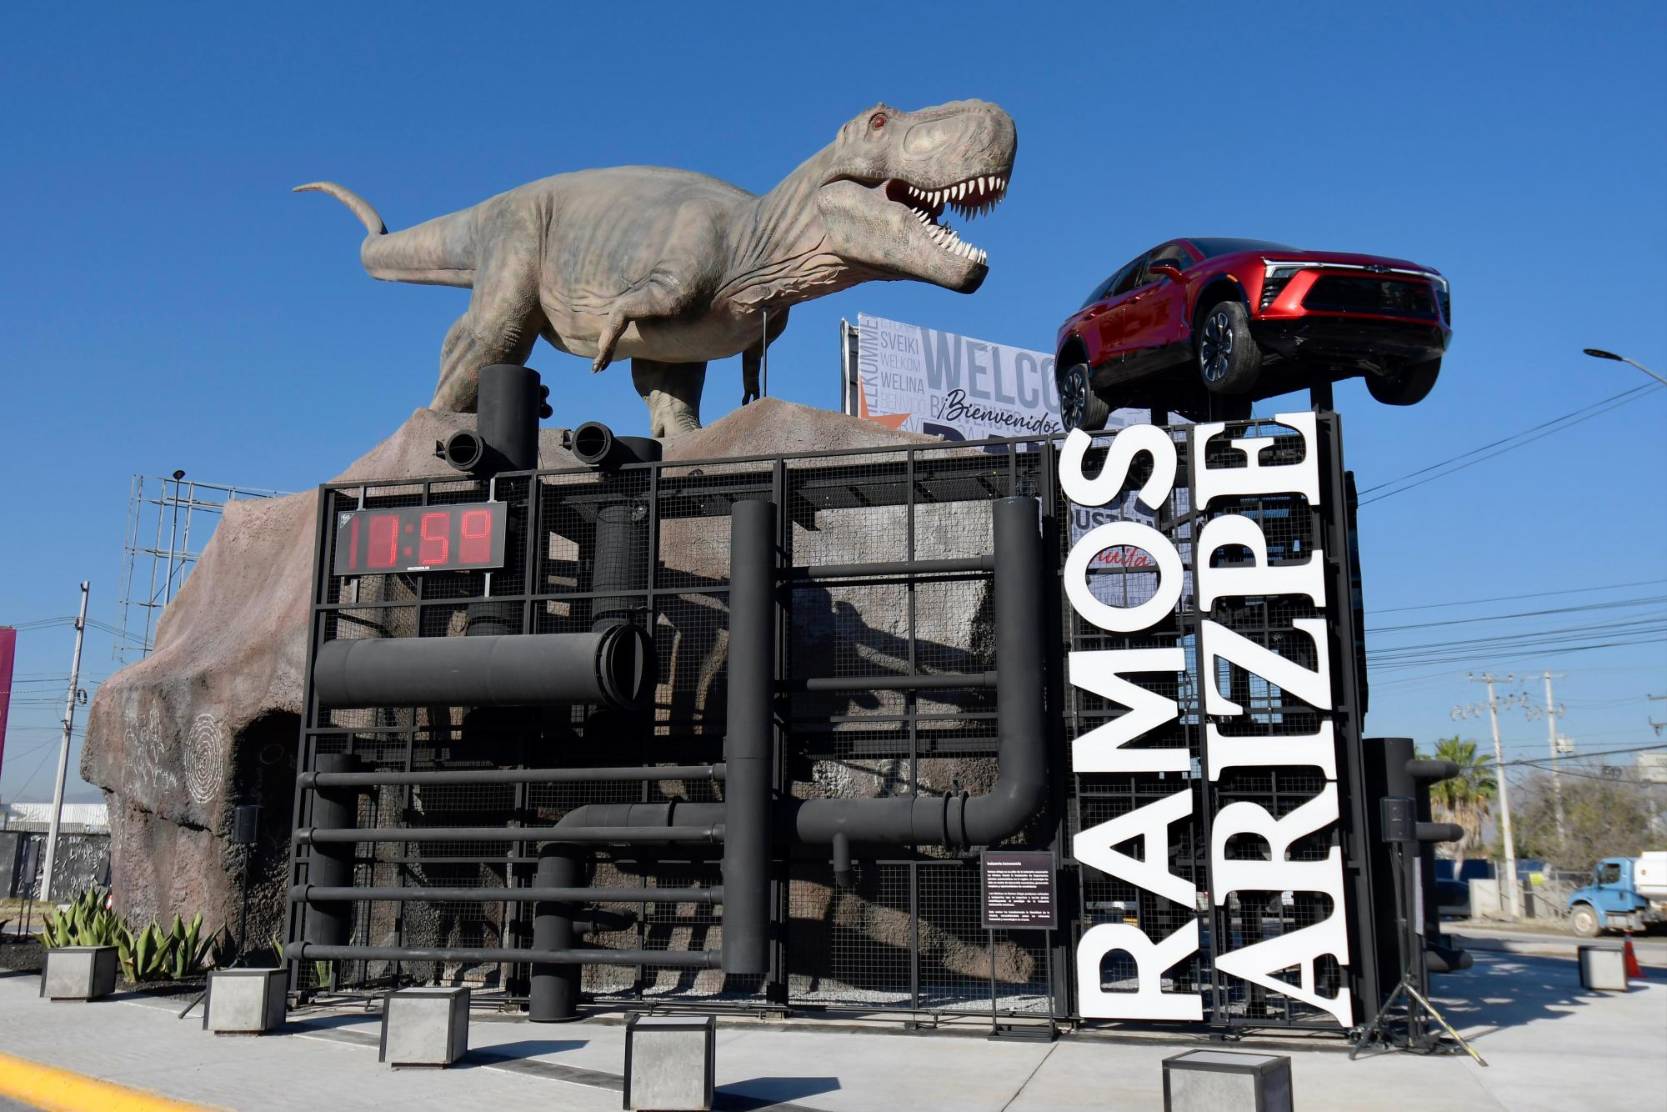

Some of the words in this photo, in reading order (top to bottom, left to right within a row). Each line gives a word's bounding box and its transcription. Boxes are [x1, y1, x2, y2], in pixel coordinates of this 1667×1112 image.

[880, 331, 920, 355] SVEIKI
[880, 372, 925, 395] WELINA
[1059, 424, 1203, 1020] RAMOS
[1194, 411, 1354, 1027] ARIZPE
